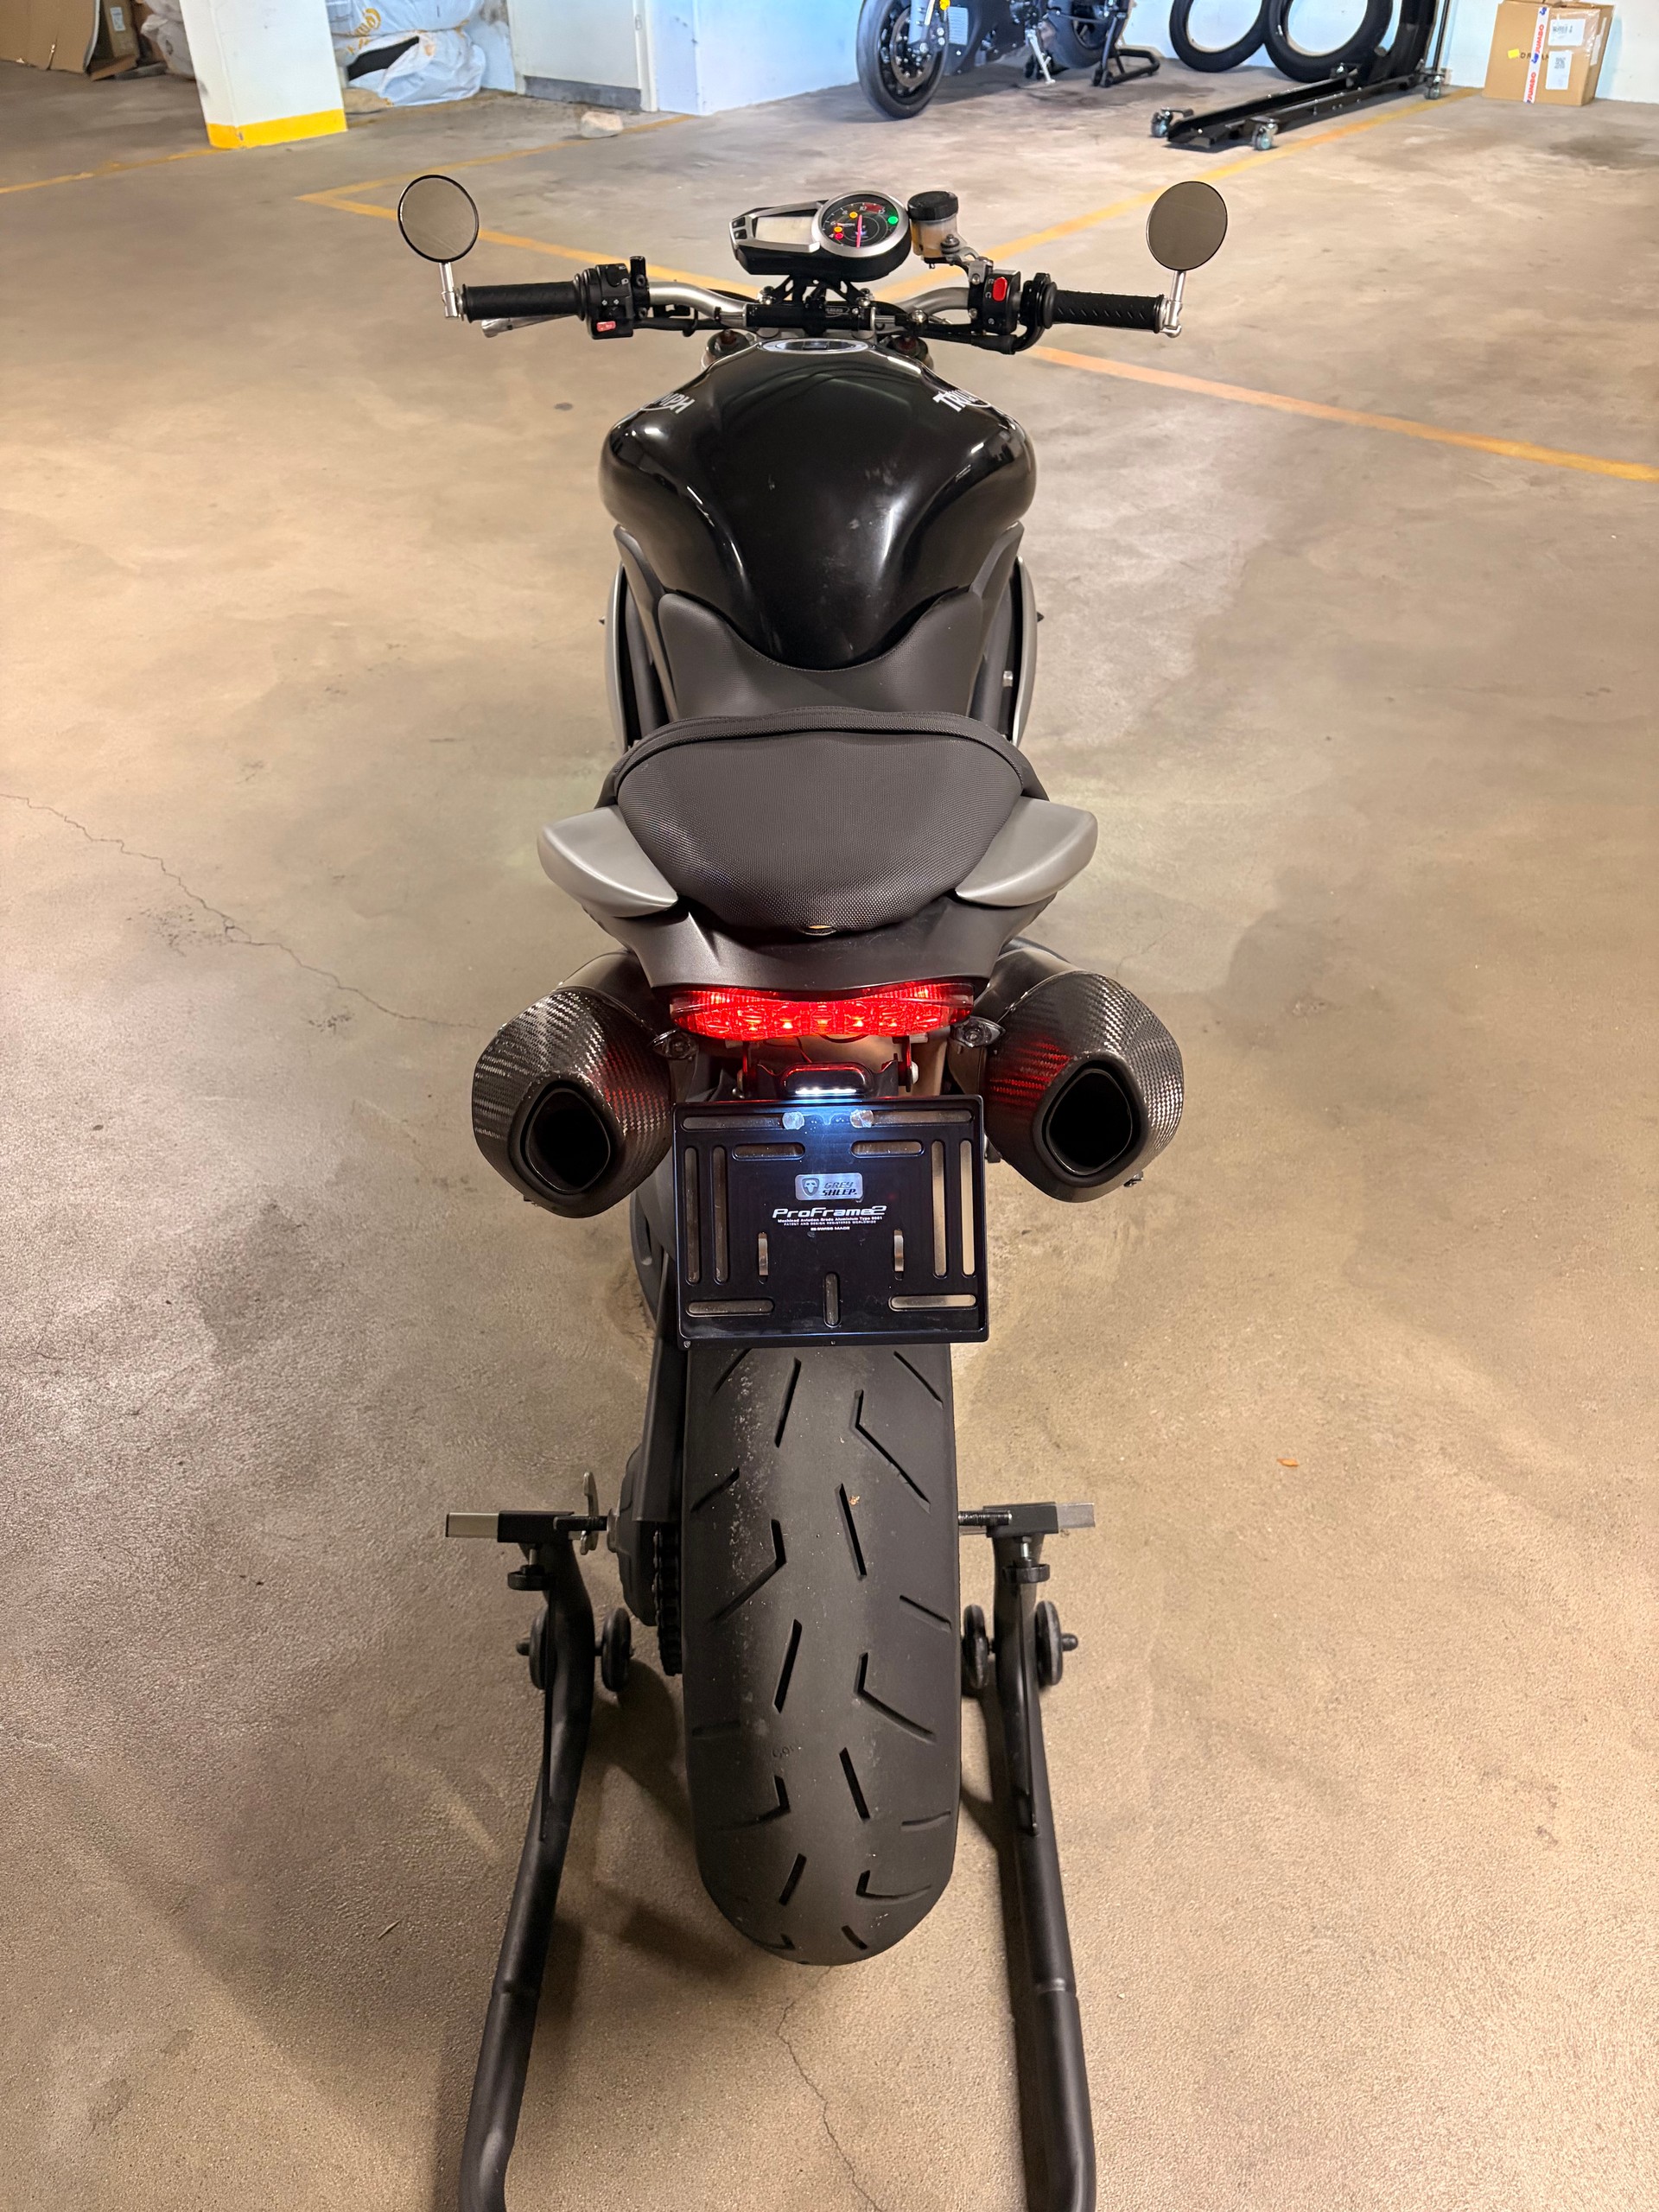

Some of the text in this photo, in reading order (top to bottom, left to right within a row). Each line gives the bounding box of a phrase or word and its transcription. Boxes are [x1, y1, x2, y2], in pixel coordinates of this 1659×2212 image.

[1535, 24, 1544, 54] JUMBO
[1528, 72, 1536, 100] JUMBO
[772, 1205, 887, 1218] ProFrame2
